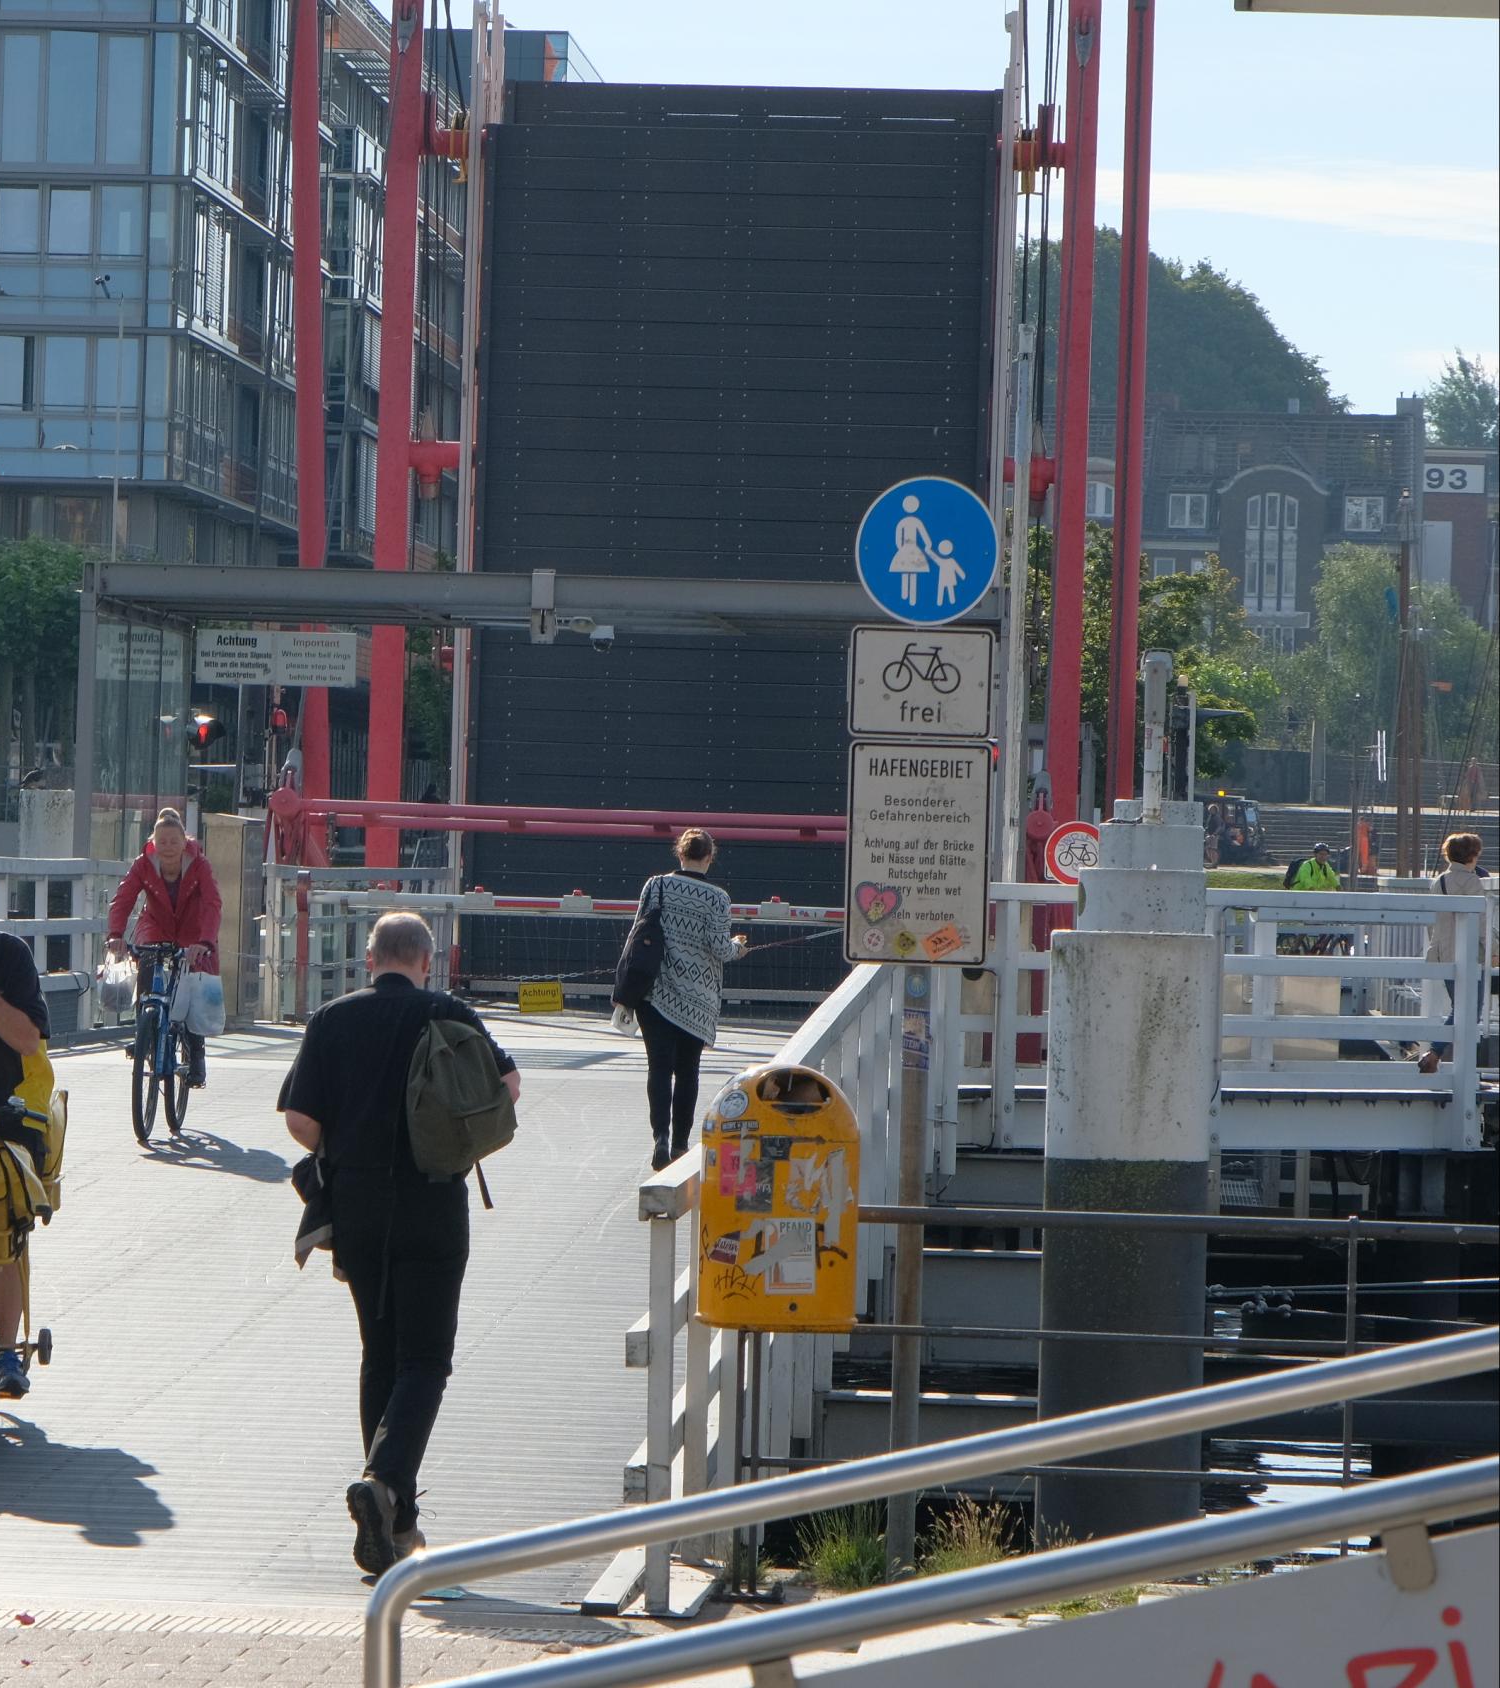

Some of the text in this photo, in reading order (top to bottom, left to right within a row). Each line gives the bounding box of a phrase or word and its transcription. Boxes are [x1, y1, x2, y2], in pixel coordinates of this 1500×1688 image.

[1426, 468, 1468, 490] 93
[216, 634, 258, 648] Achtung
[292, 637, 340, 648] Important
[900, 700, 942, 723] frei
[868, 758, 975, 779] HAFENGEBIET
[884, 794, 957, 808] Besonderer
[869, 809, 971, 824] Gefahrenbereich
[864, 837, 975, 852] Achtung auf der Brücke
[870, 852, 967, 867] bei Nässe und Glätte
[888, 867, 948, 883] Rutschgefahr
[916, 883, 940, 896] when
[944, 885, 962, 897] wet
[915, 910, 955, 921] verboten
[522, 987, 559, 999] Achtung!
